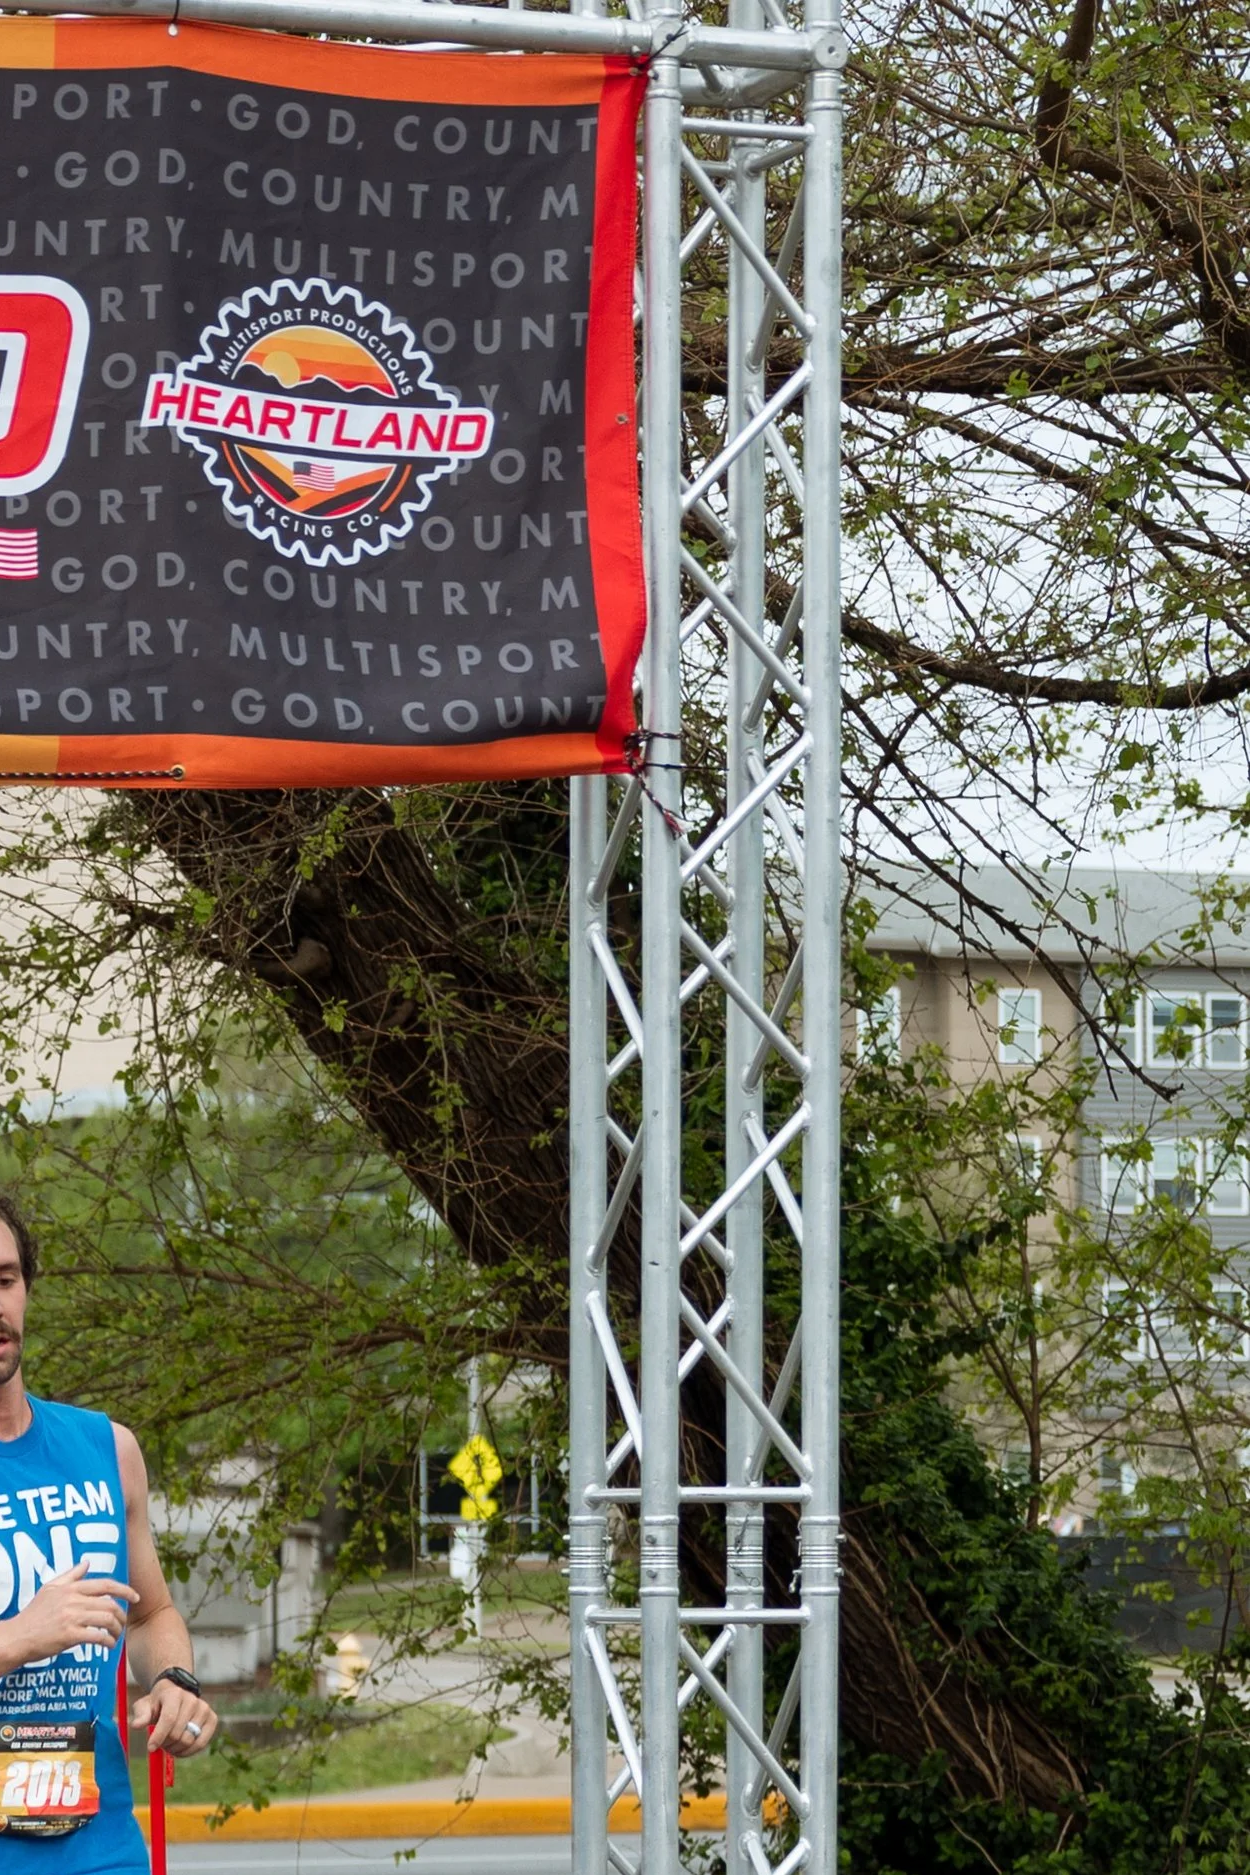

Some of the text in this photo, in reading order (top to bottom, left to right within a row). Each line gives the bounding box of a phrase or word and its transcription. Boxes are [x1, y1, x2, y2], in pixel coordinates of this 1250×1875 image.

[227, 93, 363, 150] GOD,
[55, 148, 194, 191] GOD,
[223, 160, 512, 224] COUNTRY,
[217, 308, 413, 396] MULTISPORT PRODUCTIONS
[390, 312, 588, 355] OUNT
[149, 380, 488, 453] HEARTLAND
[254, 494, 334, 537] RACING
[388, 511, 587, 551] OUNT
[52, 551, 195, 593] GOD,
[223, 559, 512, 616] COUNTRY,
[231, 686, 375, 735] GOD,
[17, 1480, 115, 1524] TEAM
[59, 1668, 93, 1684] YMCA
[1, 1759, 82, 1808] 2013
